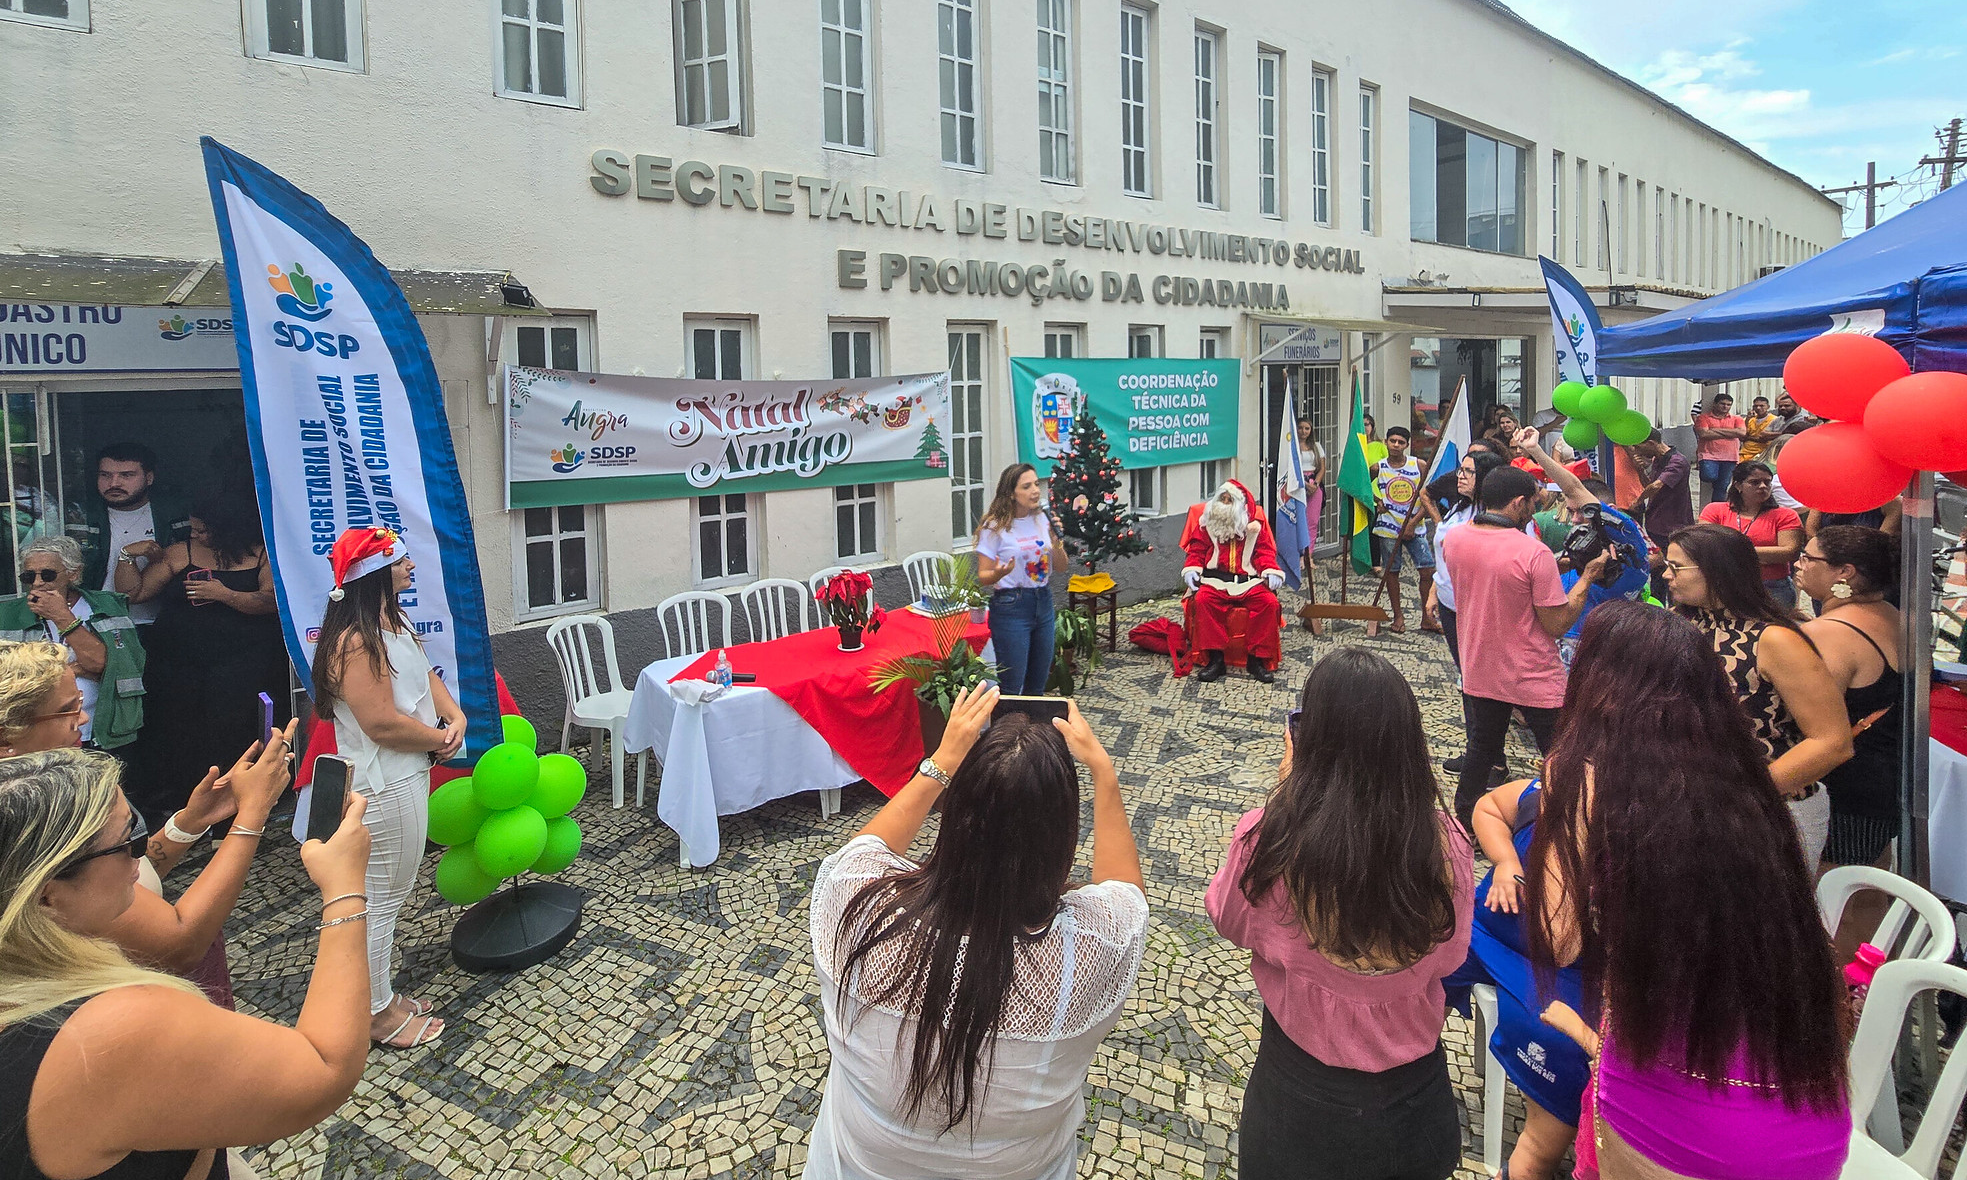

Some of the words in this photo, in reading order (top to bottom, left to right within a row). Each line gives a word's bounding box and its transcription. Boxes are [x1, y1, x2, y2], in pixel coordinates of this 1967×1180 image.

[590, 149, 945, 232] SECRETARIA
[957, 199, 1007, 238] DE
[1017, 207, 1290, 266] DESENVOLVIMENTO
[1294, 242, 1365, 274] SOCIAL
[838, 250, 867, 288] E
[880, 253, 1094, 306] PROMOÇÃO
[1102, 270, 1144, 303] DA
[1153, 275, 1290, 310] CIDADANIA
[0, 333, 86, 364] NICO
[273, 321, 360, 359] SDSP
[1284, 344, 1320, 359] FUNERÁRIOS
[1118, 370, 1218, 391] COORDENAÇÃO
[316, 375, 349, 440] SOCIAL
[1131, 391, 1188, 410] TÉCNICA
[1190, 393, 1206, 407] DA
[1392, 392, 1401, 405] 59
[353, 373, 389, 471] CIDADANIA
[561, 400, 628, 441] Angra
[669, 389, 807, 441] Natal
[1128, 414, 1180, 431] PESSOA
[1183, 413, 1209, 427] COM
[300, 419, 329, 441] DE
[1130, 431, 1208, 452] DEFICIÊNCIA
[590, 446, 637, 459] SDSP
[690, 427, 848, 483] Amigo
[368, 474, 393, 498] DA
[301, 446, 335, 556] SECRETARIA
[412, 620, 443, 635] gra
